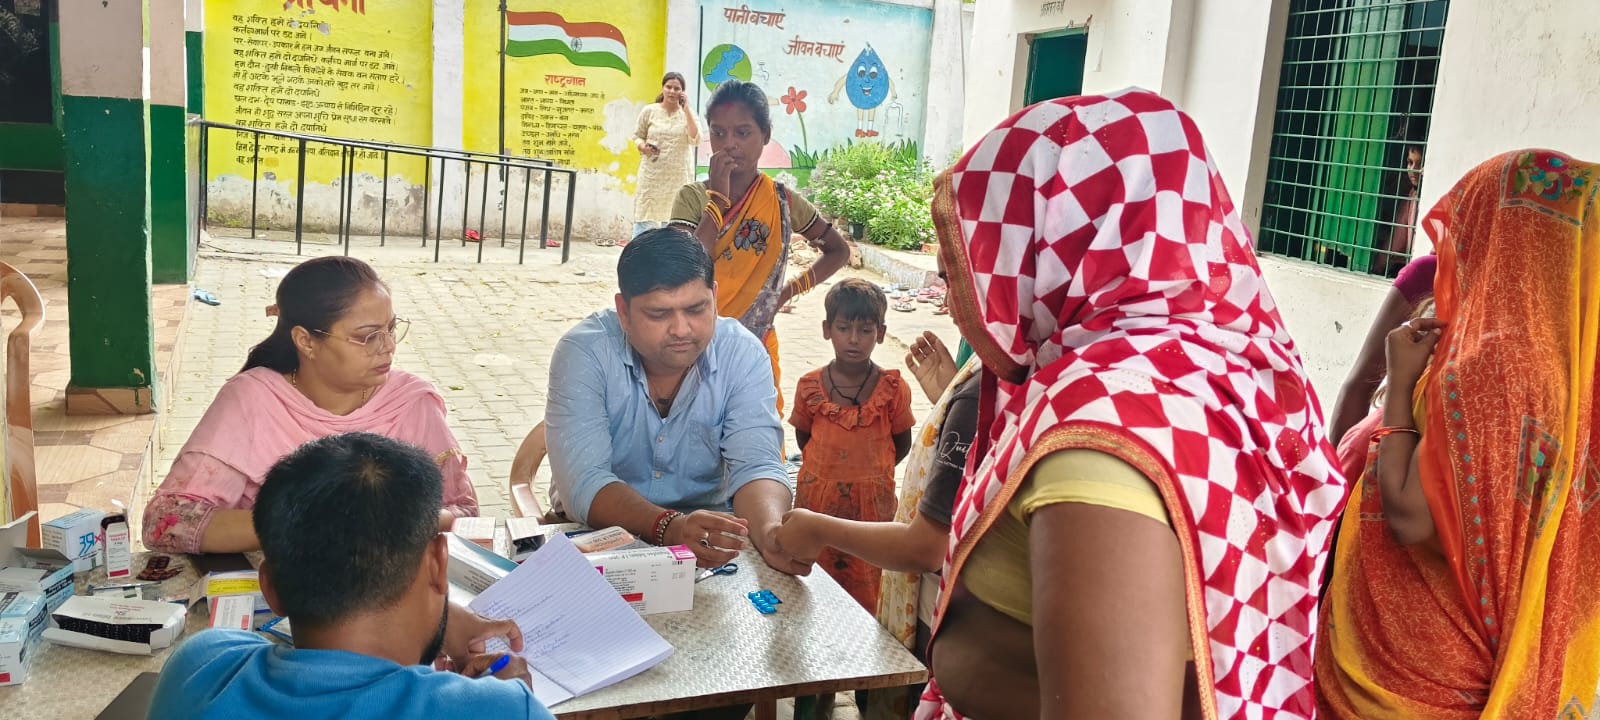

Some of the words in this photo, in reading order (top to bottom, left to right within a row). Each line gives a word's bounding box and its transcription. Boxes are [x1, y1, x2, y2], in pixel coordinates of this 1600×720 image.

[724, 4, 750, 24] पानी
[783, 34, 815, 56] जीवन
[544, 74, 586, 88] राष्ट्रगान
